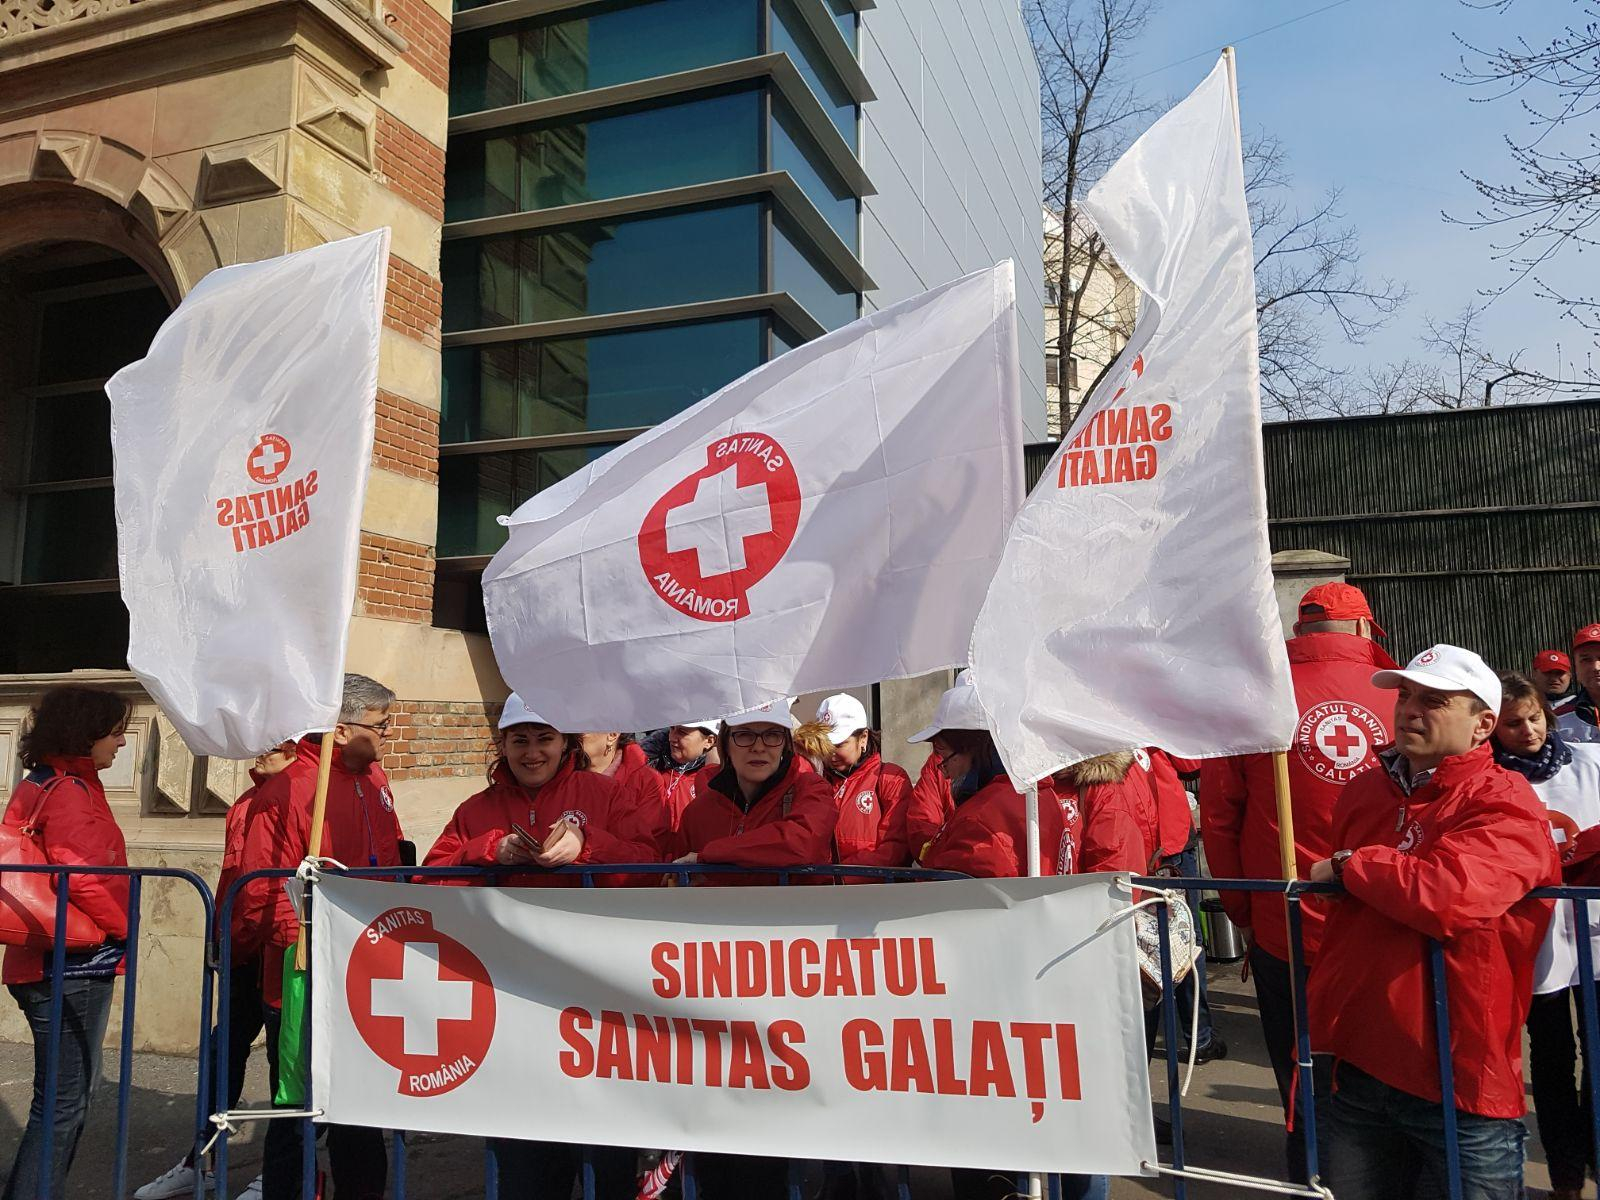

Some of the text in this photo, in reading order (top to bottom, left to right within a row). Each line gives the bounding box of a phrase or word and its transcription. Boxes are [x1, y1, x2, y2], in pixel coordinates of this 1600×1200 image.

[1300, 704, 1384, 753] SINDICATUL SANITA
[366, 911, 425, 945] SANITAS
[651, 937, 946, 999] SINDICATUL
[558, 1006, 811, 1091] SANITAS
[409, 1055, 476, 1092] ROMÂNIA
